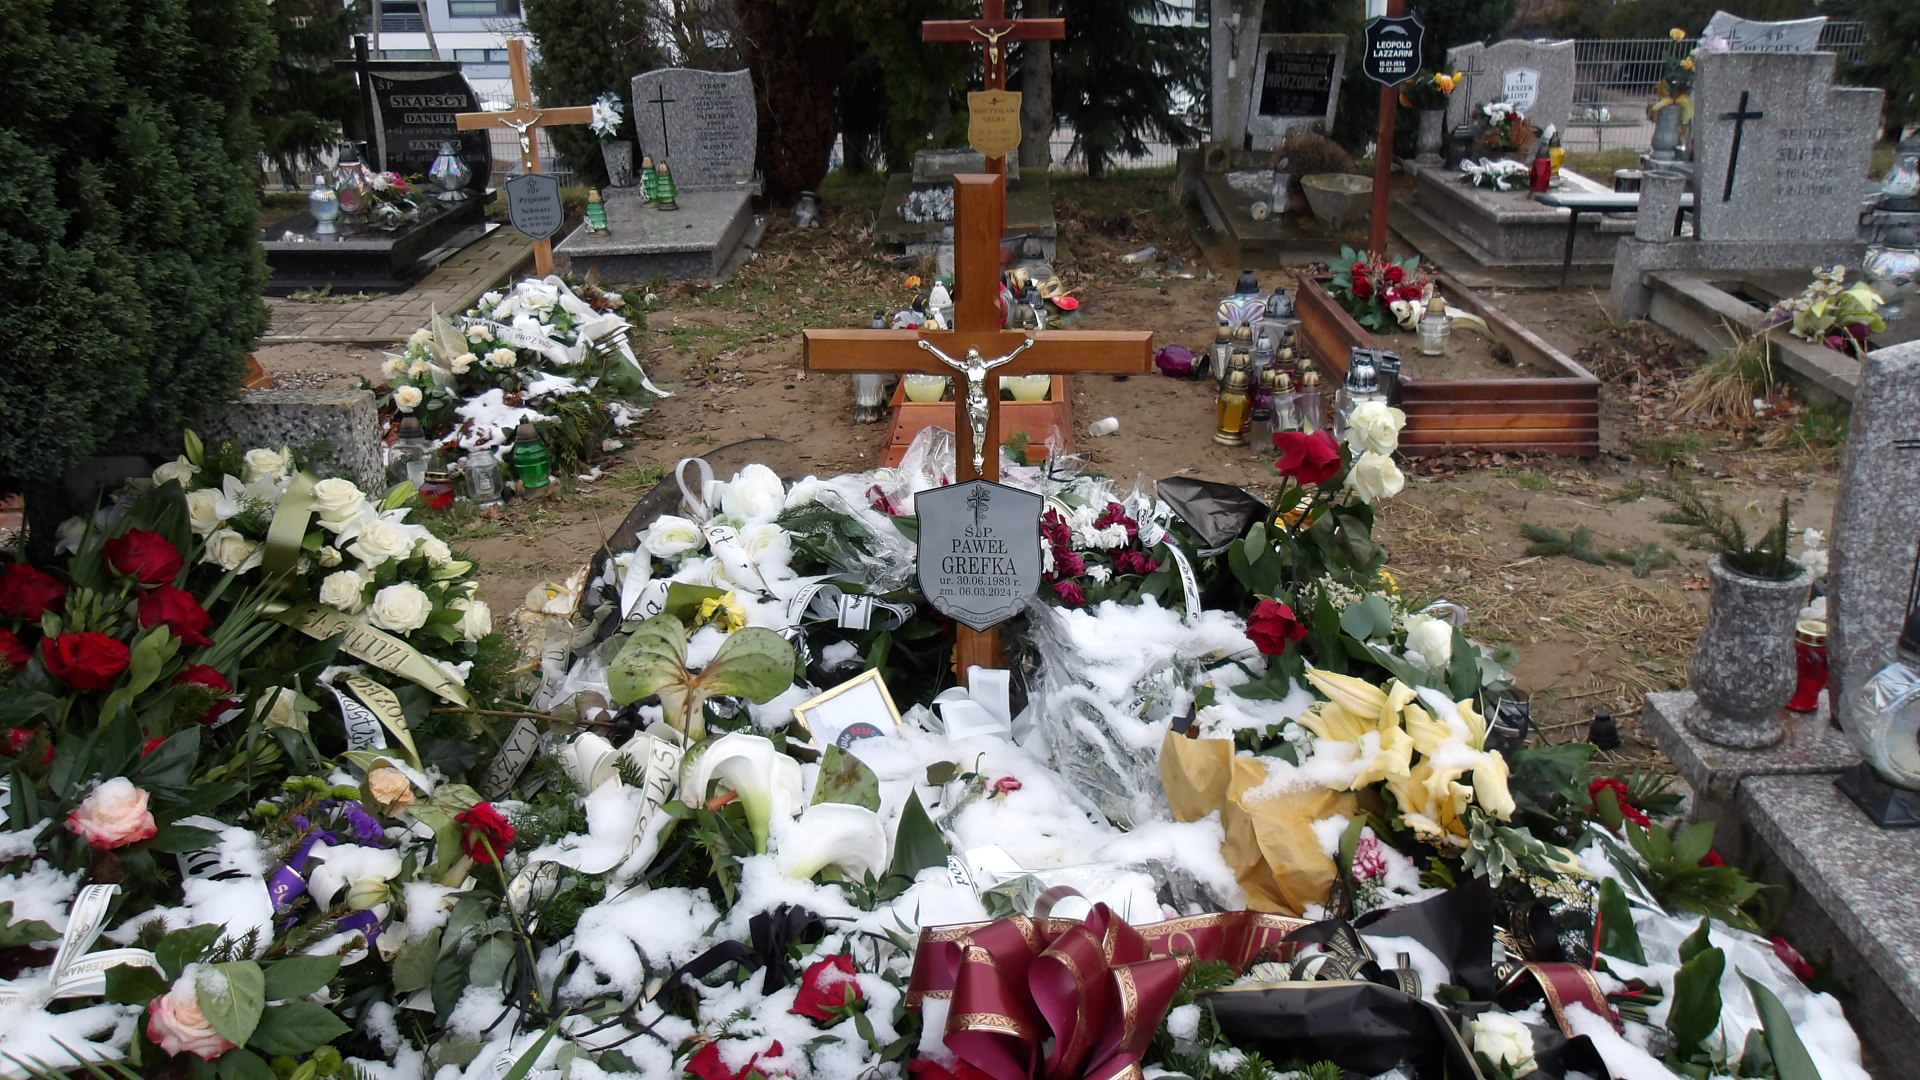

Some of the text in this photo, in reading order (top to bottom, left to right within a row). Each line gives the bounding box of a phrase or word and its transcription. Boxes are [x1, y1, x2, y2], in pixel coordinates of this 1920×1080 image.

[1376, 41, 1412, 49] LEOPOLD
[1373, 50, 1413, 58] LAZZARINI
[406, 113, 456, 123] DANUTA
[410, 140, 462, 150] JANUZ
[951, 538, 1008, 554] PAWEŁ
[941, 556, 1017, 575] GREFKA
[939, 576, 1021, 587] ur. 30.06.1983 r.
[939, 588, 956, 596] zm.
[959, 587, 1011, 597] 06.03.2024
